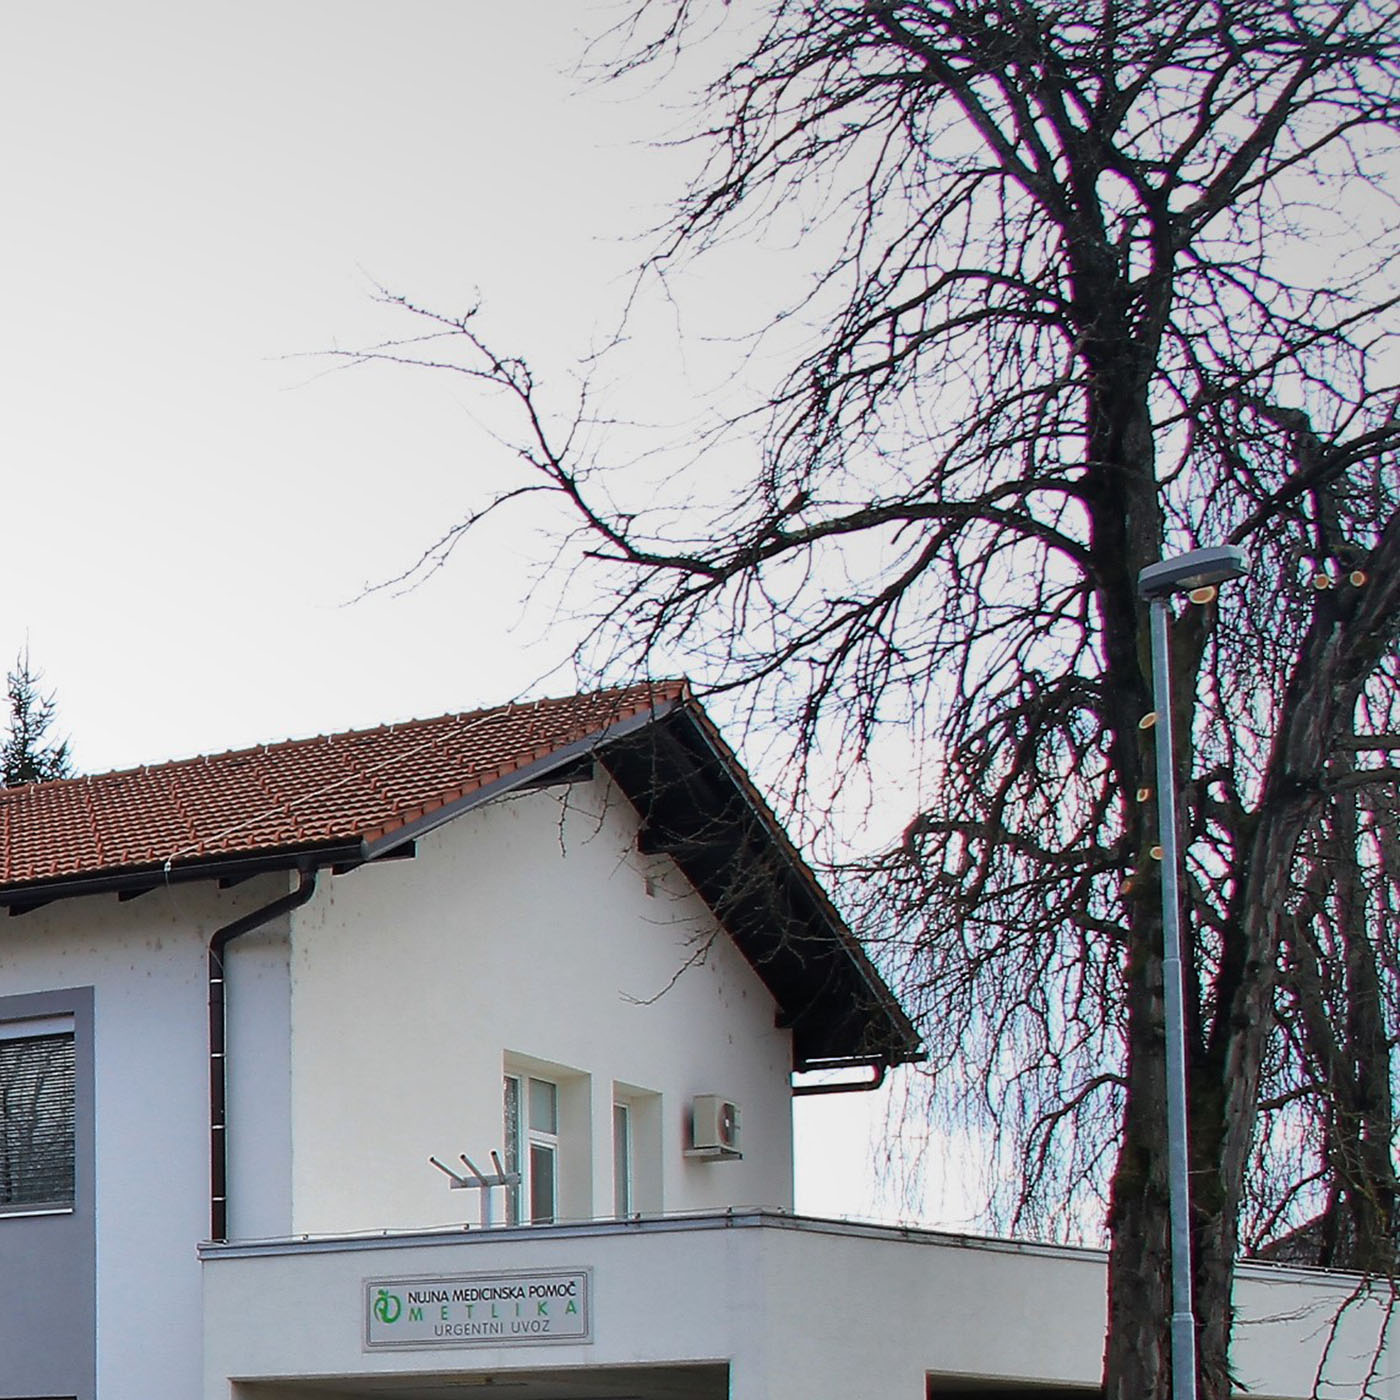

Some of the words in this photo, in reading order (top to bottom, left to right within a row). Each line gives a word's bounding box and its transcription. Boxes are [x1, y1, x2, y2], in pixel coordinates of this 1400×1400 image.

[408, 1290, 449, 1304] NUJNA
[452, 1286, 525, 1302] MEDICINSKA
[528, 1281, 576, 1298] POMOČ
[408, 1300, 577, 1321] METLIKA
[434, 1322, 503, 1336] URGENTNI
[511, 1320, 550, 1333] UVOZ
